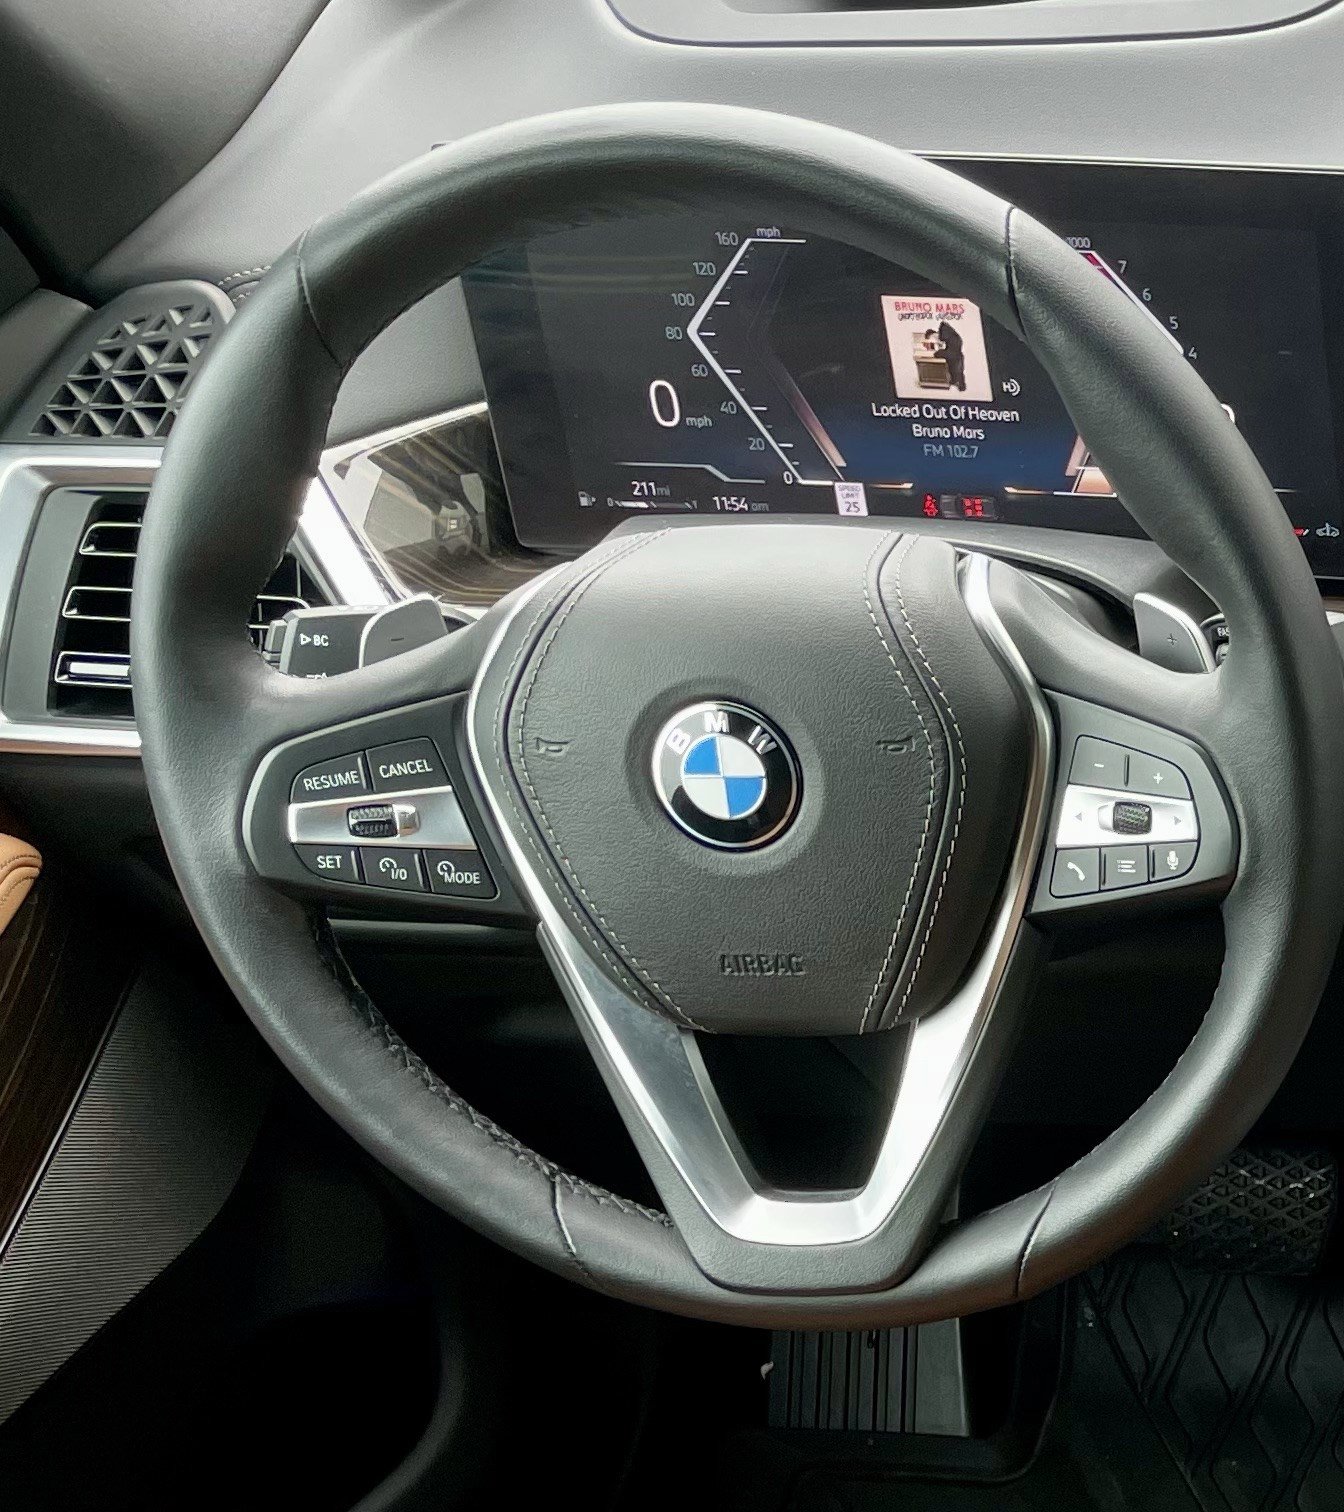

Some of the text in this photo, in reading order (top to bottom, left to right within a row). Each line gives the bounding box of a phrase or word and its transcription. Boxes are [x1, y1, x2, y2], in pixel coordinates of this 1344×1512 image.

[715, 232, 738, 245] 160
[756, 226, 781, 239] mph
[693, 262, 716, 276] 120
[1118, 260, 1127, 274] 7
[672, 293, 695, 306] 100
[1142, 288, 1152, 301] 6
[894, 302, 965, 315] BRUNO MARS
[1169, 316, 1179, 330] 5
[665, 327, 682, 340] 80
[1189, 347, 1198, 360] 4
[691, 364, 708, 377] 60
[650, 380, 713, 428] 0 mph
[720, 402, 737, 414] 40
[871, 402, 1020, 422] Locked Out Of Heaven
[912, 424, 985, 440] Bruno Mars
[748, 438, 765, 450] 20
[923, 444, 979, 459] FM 102.7
[783, 471, 793, 485] 0
[845, 501, 860, 513] 25
[313, 634, 329, 647] BC
[666, 711, 777, 754] BMW
[379, 759, 433, 778] CANCEL
[303, 771, 360, 791] RESUME
[316, 855, 342, 869] SET
[444, 872, 481, 884] MODE
[719, 953, 806, 976] AIRBAG
